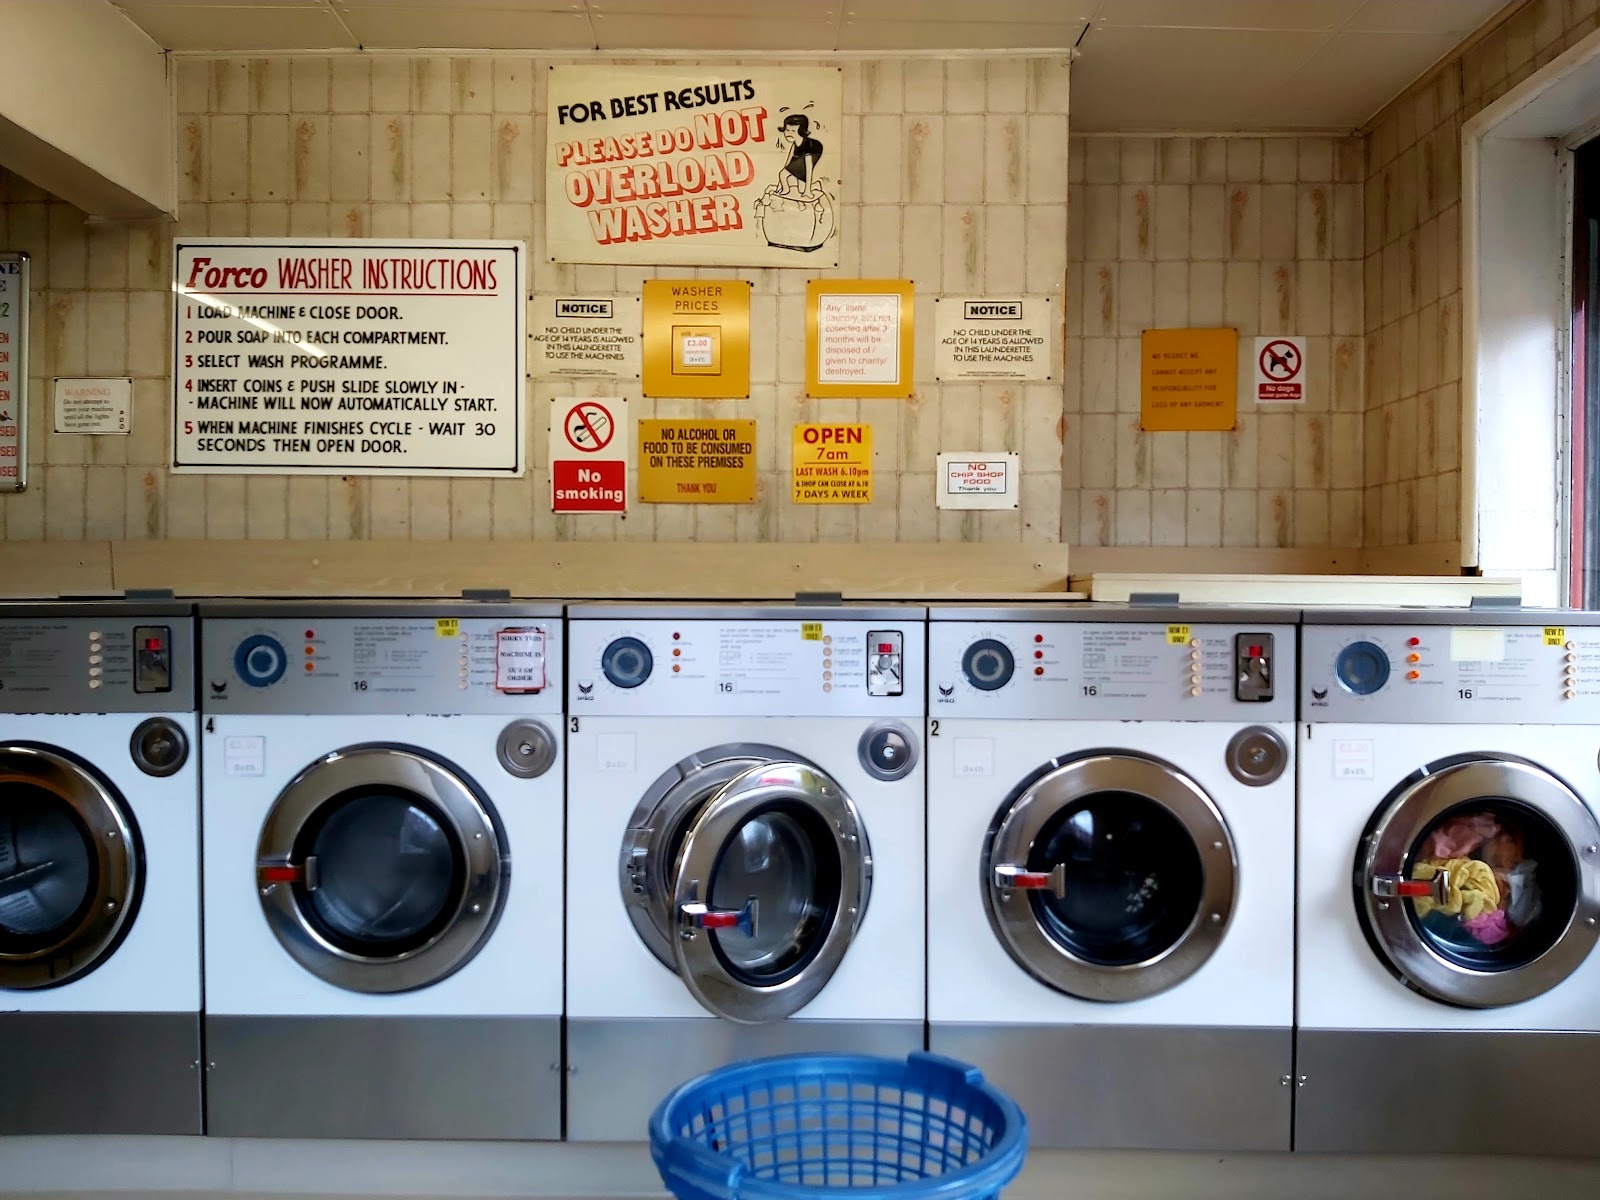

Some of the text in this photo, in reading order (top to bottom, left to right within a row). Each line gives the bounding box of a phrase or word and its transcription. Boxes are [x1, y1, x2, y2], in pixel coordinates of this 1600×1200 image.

[558, 80, 755, 124] FOR BEST RESULTS
[555, 106, 767, 167] PLEASE DO NOT
[565, 151, 754, 207] OVERLOAD
[587, 194, 742, 245] WASHER
[186, 258, 497, 290] Forco WASHER INSTRUCTIONS
[672, 286, 722, 296] WASHER
[562, 304, 607, 313] NOTICE
[675, 300, 718, 310] PRICES
[826, 304, 841, 312] Any
[970, 306, 1016, 315] NOTICE
[187, 306, 403, 320] 1 LOAD MACHINE CLOSE DOOR.
[545, 326, 558, 334] NO
[560, 326, 581, 334] CHILD
[186, 330, 448, 345] 2 POUR SOAP INTO EACH COMPARTMENT.
[534, 334, 548, 342] AGE
[573, 344, 621, 352] LAUNDERETTE
[185, 355, 387, 369] 3 SELECT WASH PROGRAMME.
[825, 358, 846, 366] given
[64, 388, 111, 396] WARNING
[185, 379, 457, 394] 4 INSERT COINS PUSH SLIDE SLOWLY IN
[1277, 385, 1295, 393] dogs
[198, 396, 497, 411] MACHINE WILL NOW AUTOMATICALLY START.
[185, 421, 496, 436] 5 WHEN MACHINE FINISHES CYCLE WAIT 30
[661, 429, 736, 441] NO ALCOHOL OR
[803, 427, 862, 444] OPEN
[198, 438, 407, 453] SECONDS THEN OPEN DOOR.
[643, 442, 751, 455] FOOD TO BE CONSUMED
[817, 447, 848, 460] 7am
[650, 456, 744, 468] ON THESE PREMISES
[578, 469, 601, 483] No
[796, 468, 813, 476] LAST
[816, 468, 838, 476] WASH
[556, 487, 624, 502] smoking
[677, 483, 716, 493] THANK YOU
[796, 490, 868, 498] 7 DAYS A WEEK
[354, 680, 368, 691] 16
[719, 682, 732, 693] 16
[1082, 686, 1097, 696] 16
[1458, 689, 1472, 699] 16
[206, 718, 214, 733] 4
[571, 717, 579, 732] 3
[931, 720, 939, 736] 2
[1307, 724, 1311, 739] 1
